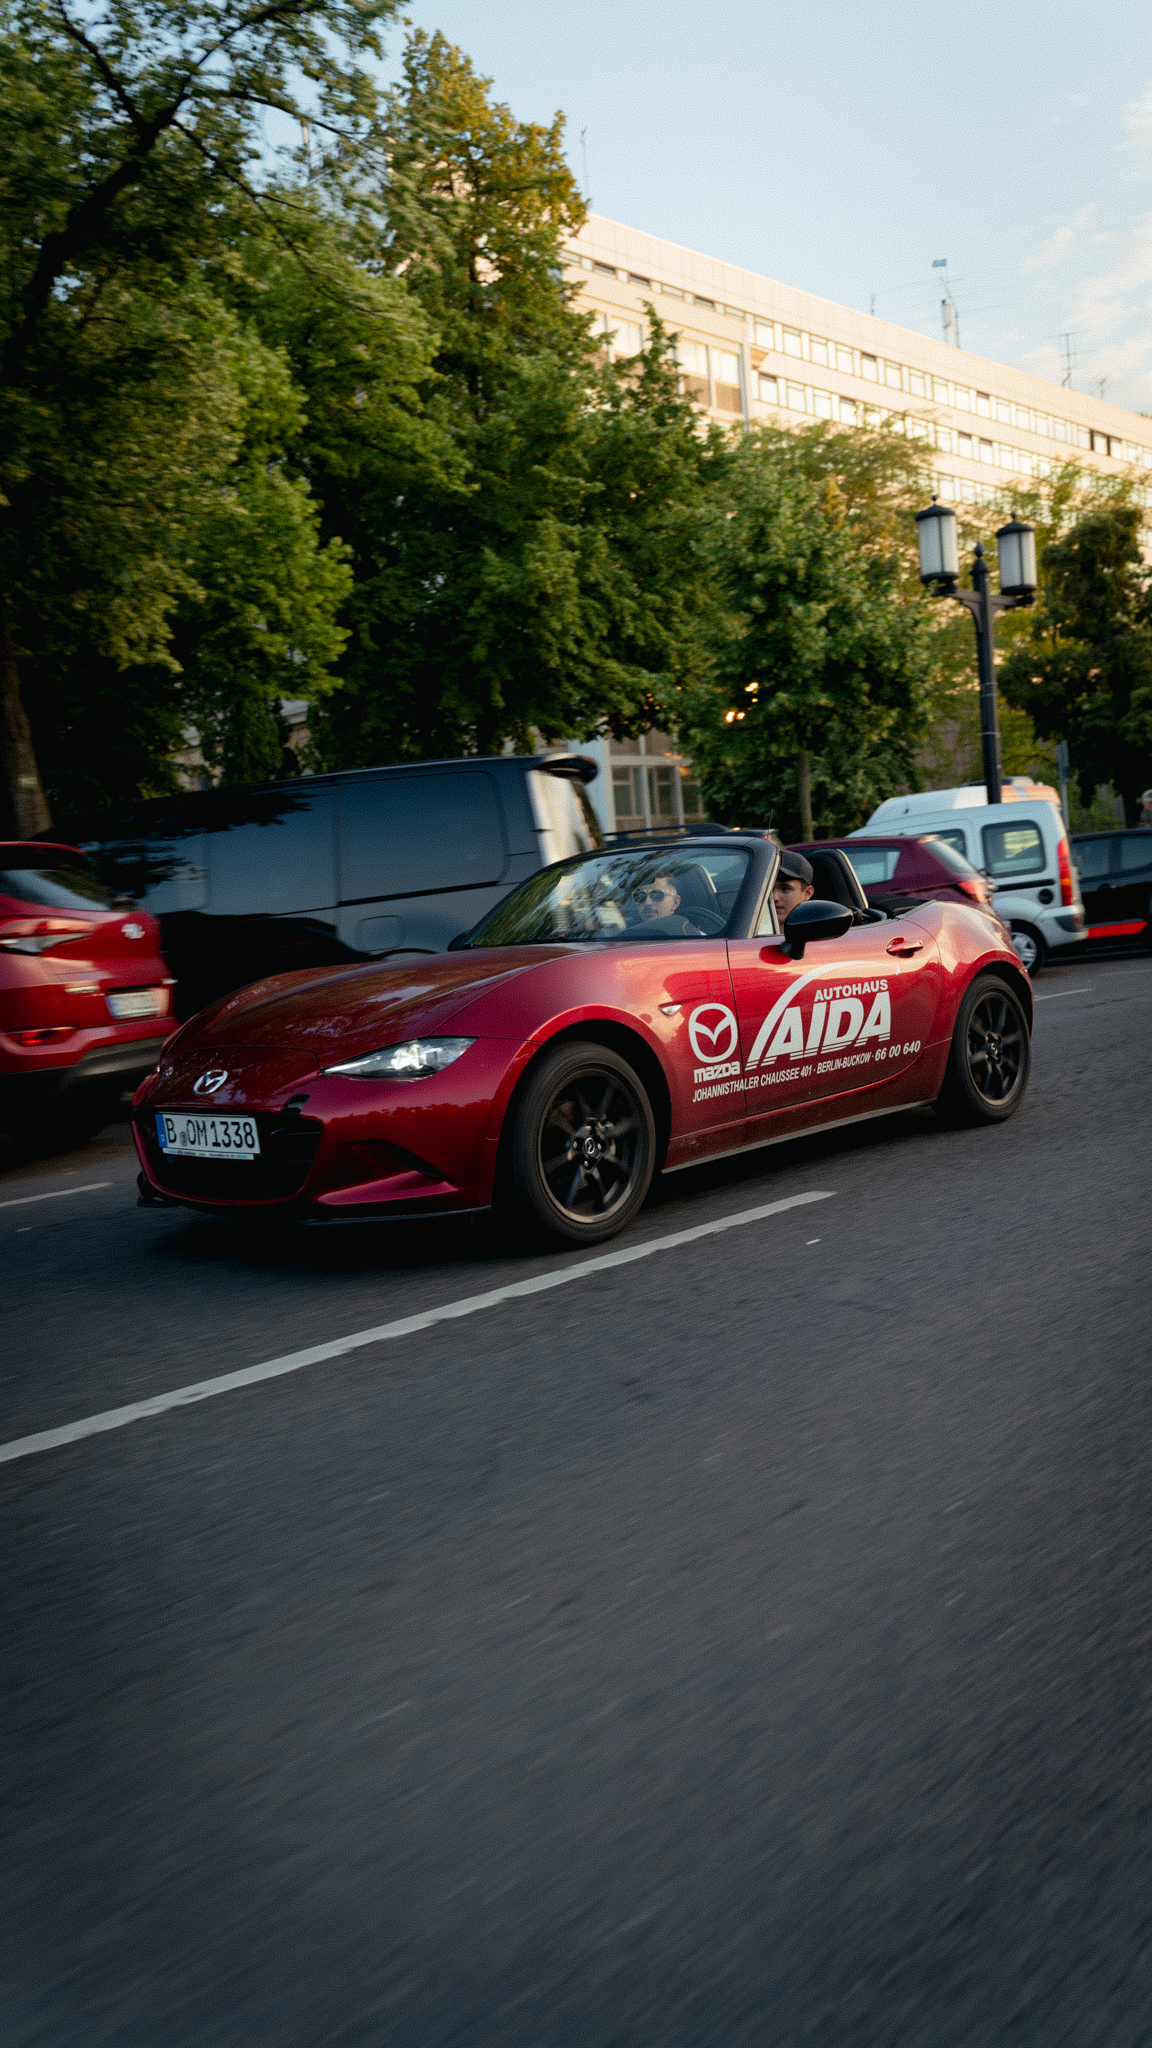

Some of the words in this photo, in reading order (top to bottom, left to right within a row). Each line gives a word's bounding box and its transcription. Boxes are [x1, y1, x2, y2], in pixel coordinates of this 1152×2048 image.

[814, 979, 888, 1002] AUTOHAUS
[761, 991, 891, 1067] AIDA
[692, 1076, 759, 1103] JOHANNISTHALER
[760, 1067, 800, 1087] CHAUSSEE
[800, 1064, 813, 1078] 401
[816, 1052, 872, 1074] BERLIN-BUCKOW
[874, 1048, 887, 1062] 66
[888, 1045, 901, 1058] 00
[903, 1040, 921, 1055] 640
[165, 1117, 177, 1143] B
